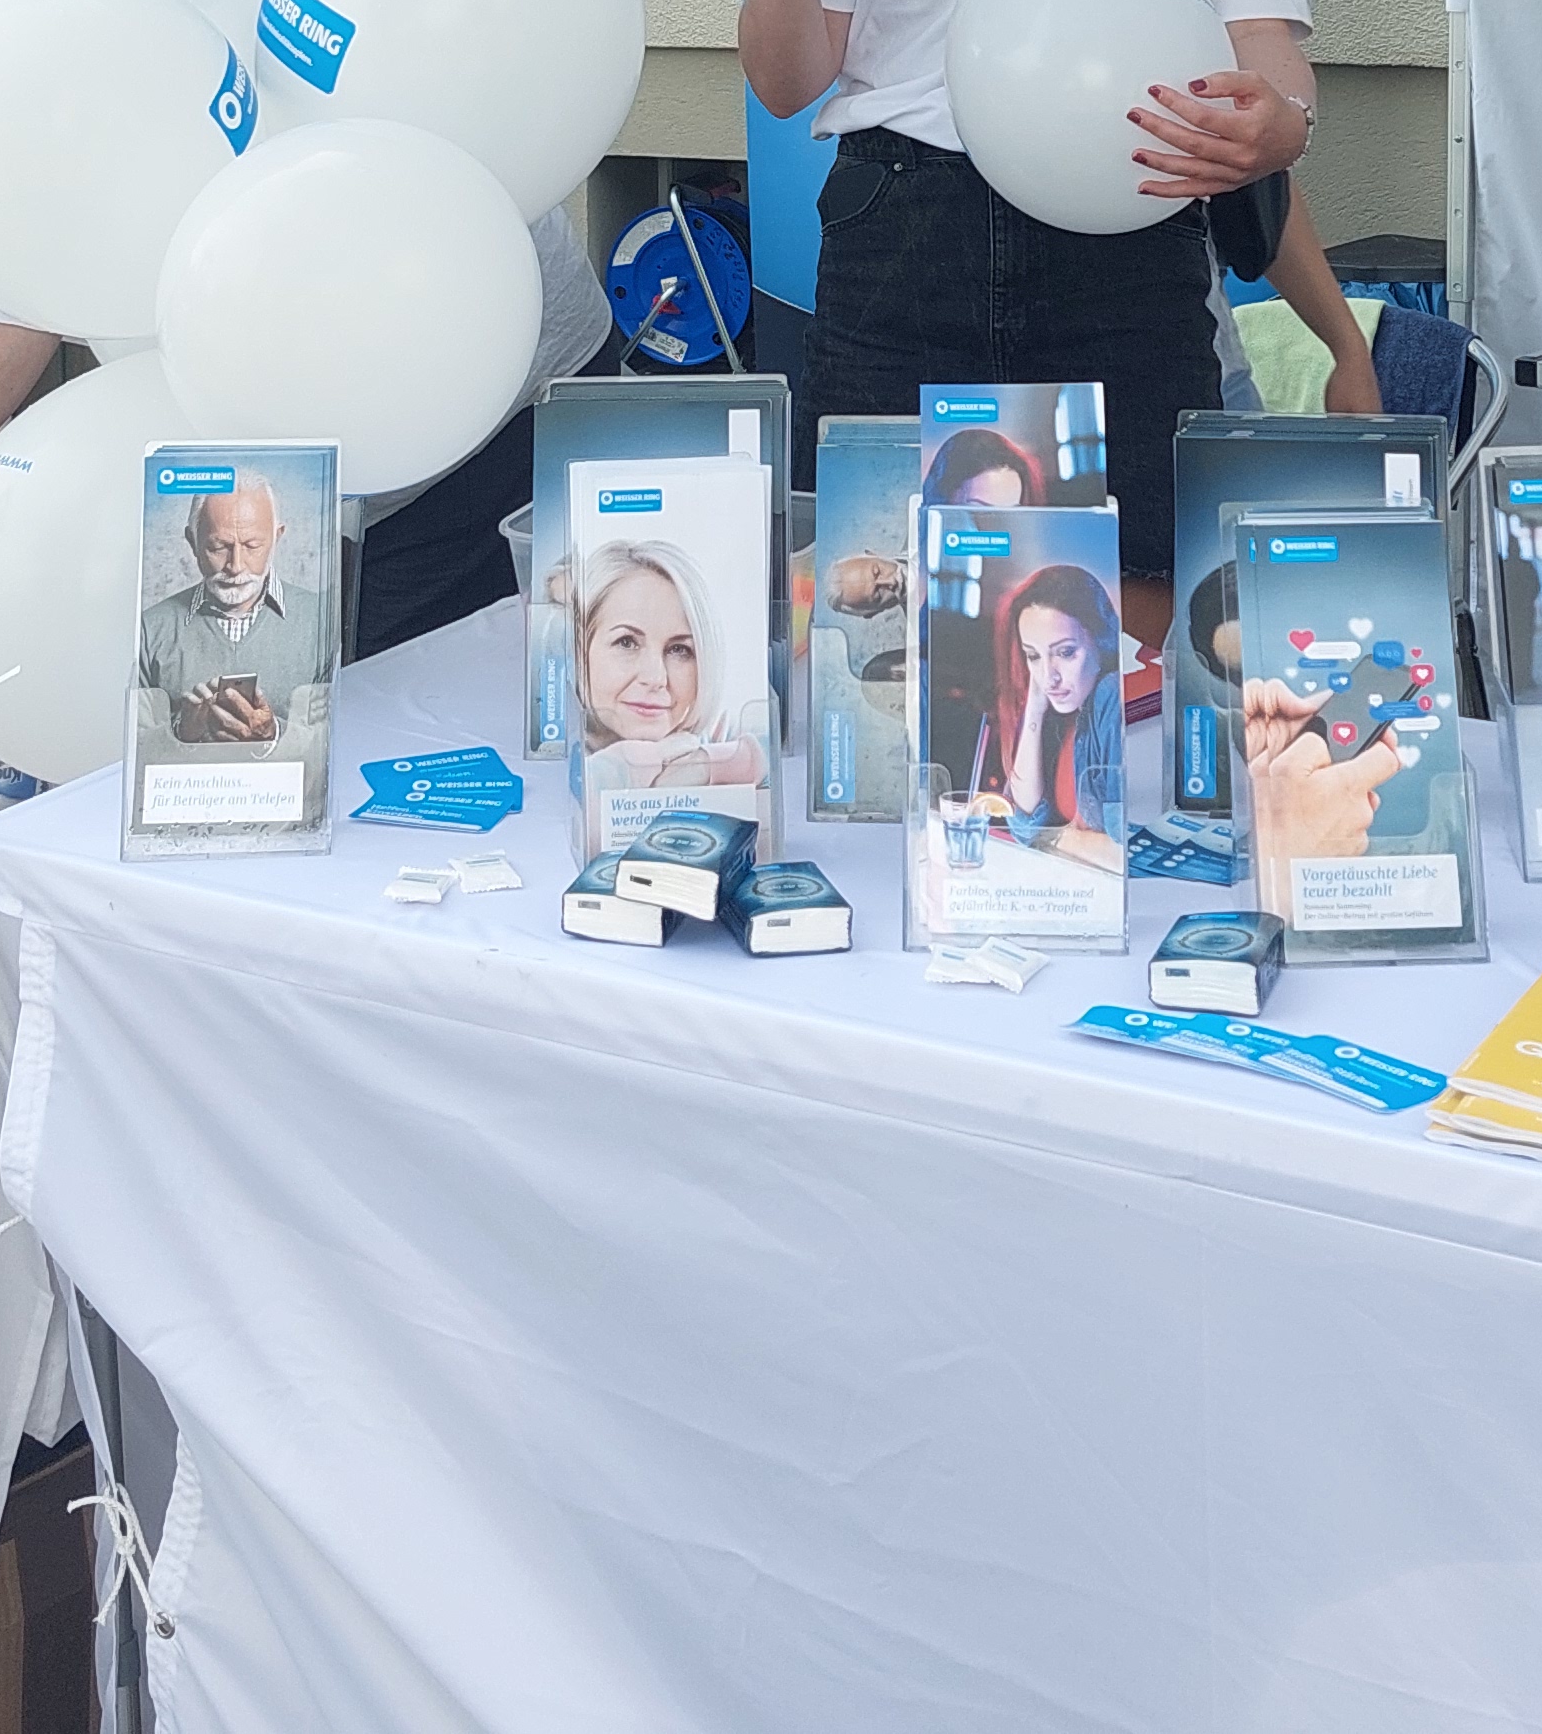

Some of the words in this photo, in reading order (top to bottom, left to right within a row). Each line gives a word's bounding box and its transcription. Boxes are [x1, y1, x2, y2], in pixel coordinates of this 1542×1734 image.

[299, 13, 344, 56] RING
[611, 798, 638, 811] Was
[640, 797, 662, 810] aus
[665, 795, 701, 809] Liebe
[1302, 866, 1398, 885] Vorgetäuschte
[1402, 865, 1439, 880] Liebe
[1303, 886, 1338, 898] teuer
[1342, 883, 1393, 898] bezahlt
